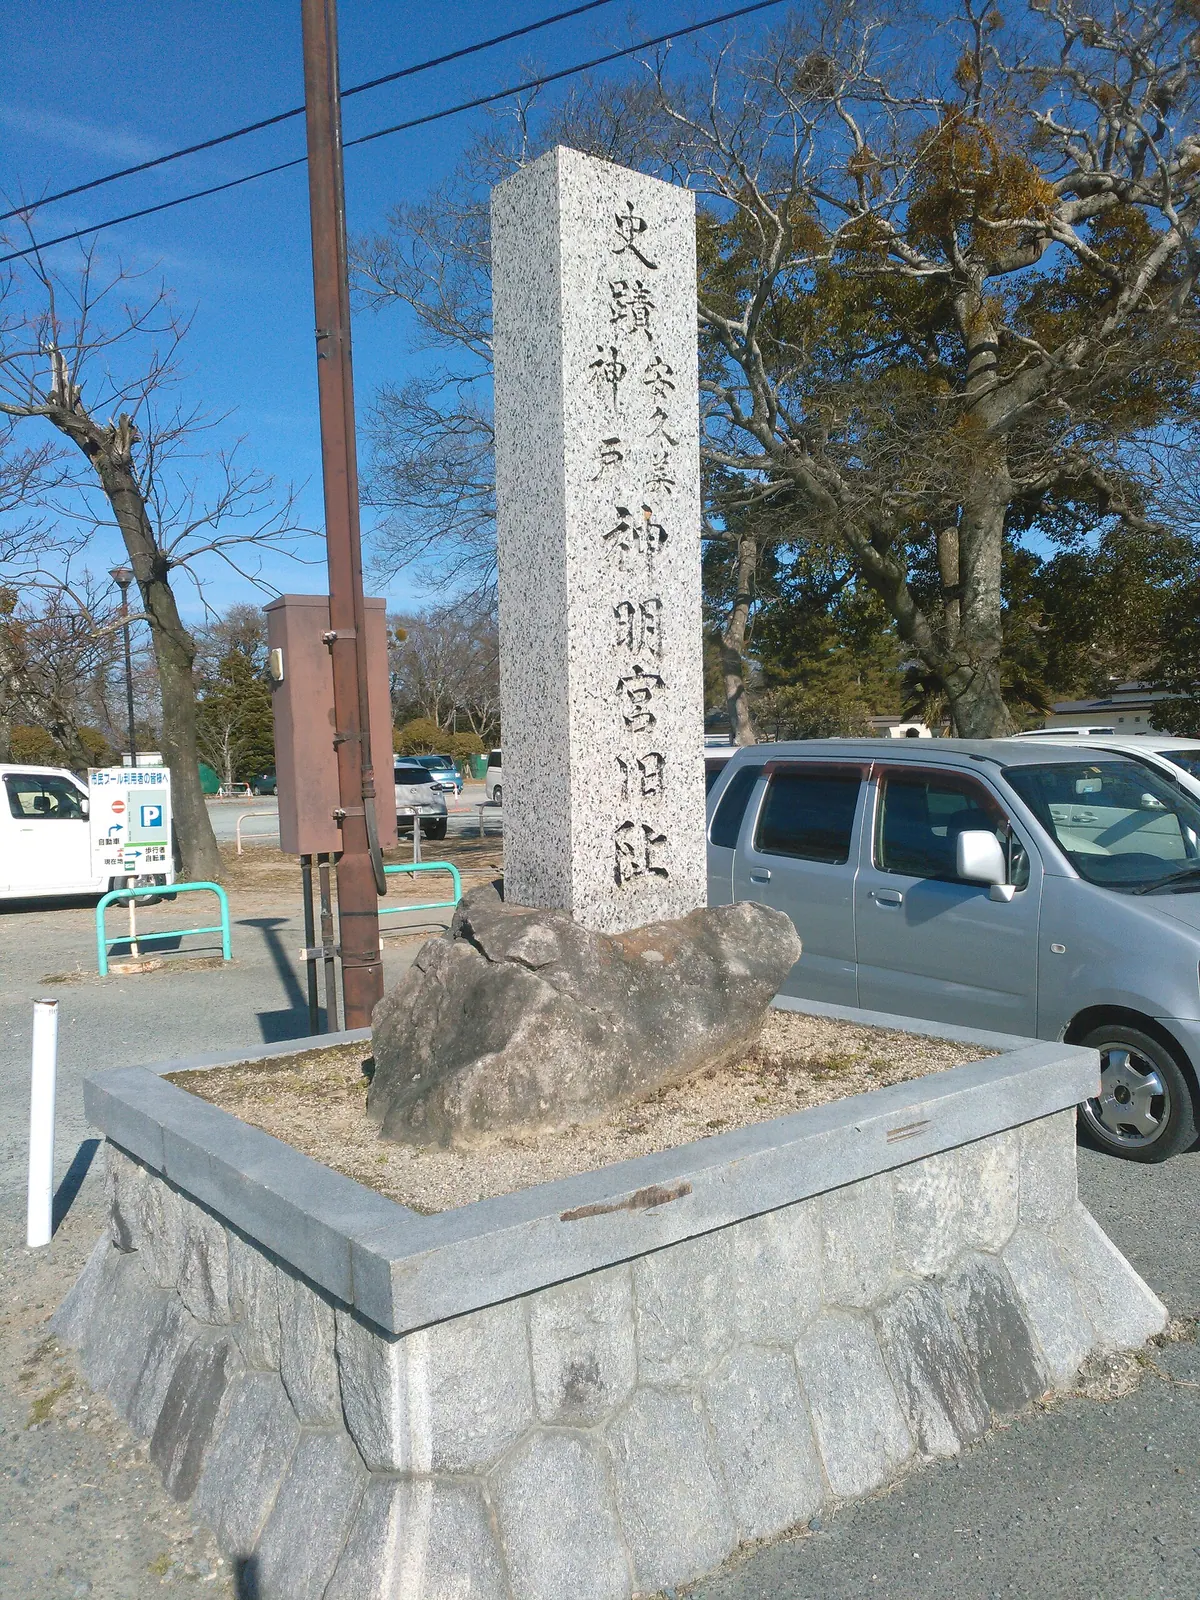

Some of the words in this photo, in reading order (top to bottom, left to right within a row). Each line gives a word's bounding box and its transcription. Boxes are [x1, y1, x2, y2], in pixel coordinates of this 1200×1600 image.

[143, 806, 160, 827] P
[98, 838, 120, 846] 自動車
